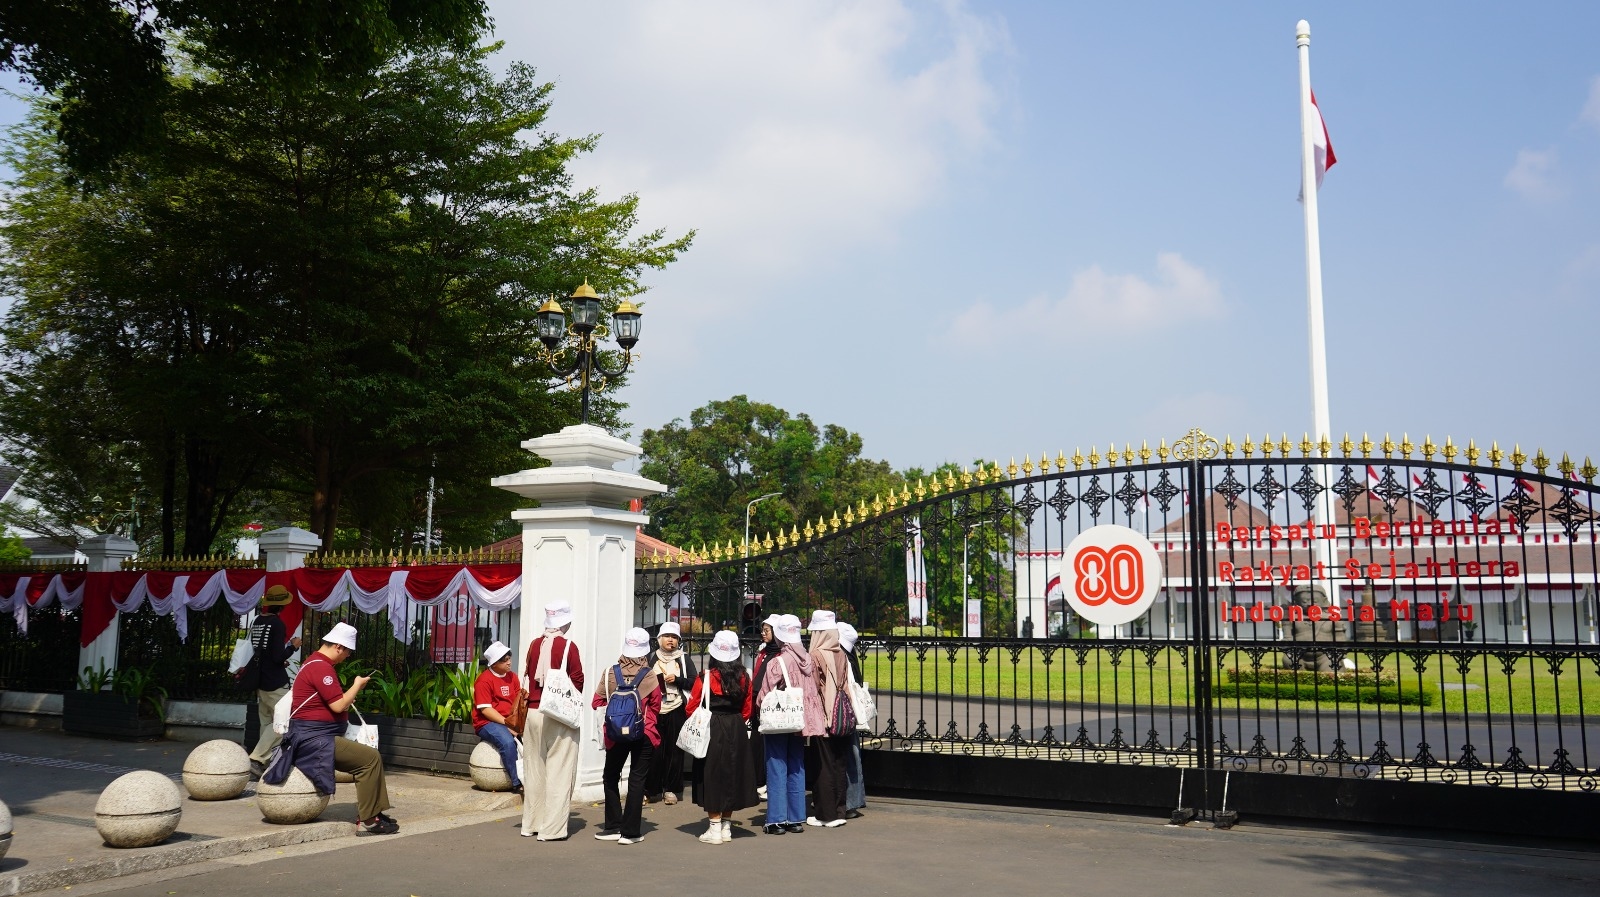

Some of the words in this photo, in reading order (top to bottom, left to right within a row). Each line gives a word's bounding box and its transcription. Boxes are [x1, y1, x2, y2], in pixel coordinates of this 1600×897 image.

[1217, 520, 1337, 542] Bersatu
[1355, 513, 1518, 539] Berdaulat
[1074, 544, 1144, 606] 80
[1219, 561, 1327, 586] Rakyat
[1345, 551, 1519, 579] Sejahtera
[1221, 598, 1375, 622] Indonesia
[1390, 592, 1473, 622] Maju
